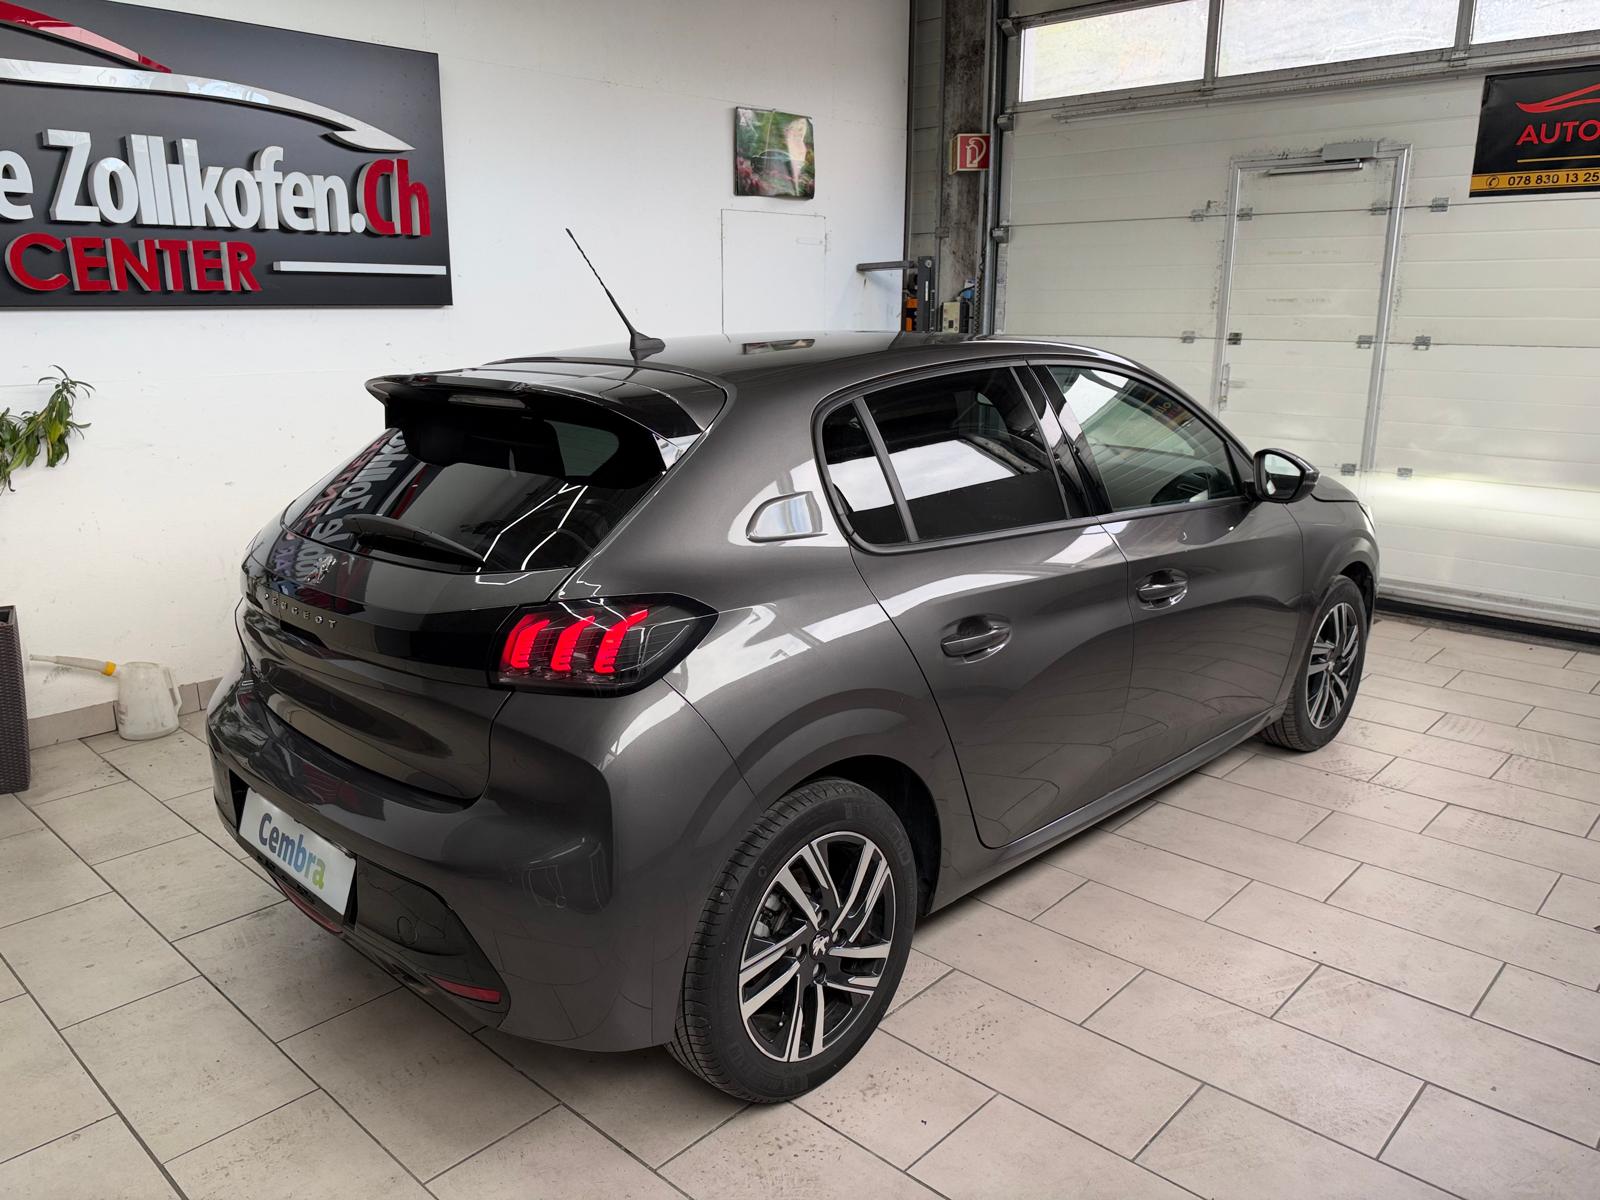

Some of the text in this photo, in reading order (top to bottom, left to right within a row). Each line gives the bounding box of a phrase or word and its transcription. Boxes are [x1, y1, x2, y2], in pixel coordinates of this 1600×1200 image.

[1515, 119, 1600, 146] AUTO
[1507, 171, 1600, 186] 078 830 13 25
[5, 232, 261, 292] CENTER
[263, 592, 337, 629] PEUGEOT
[258, 812, 326, 890] Cembra
